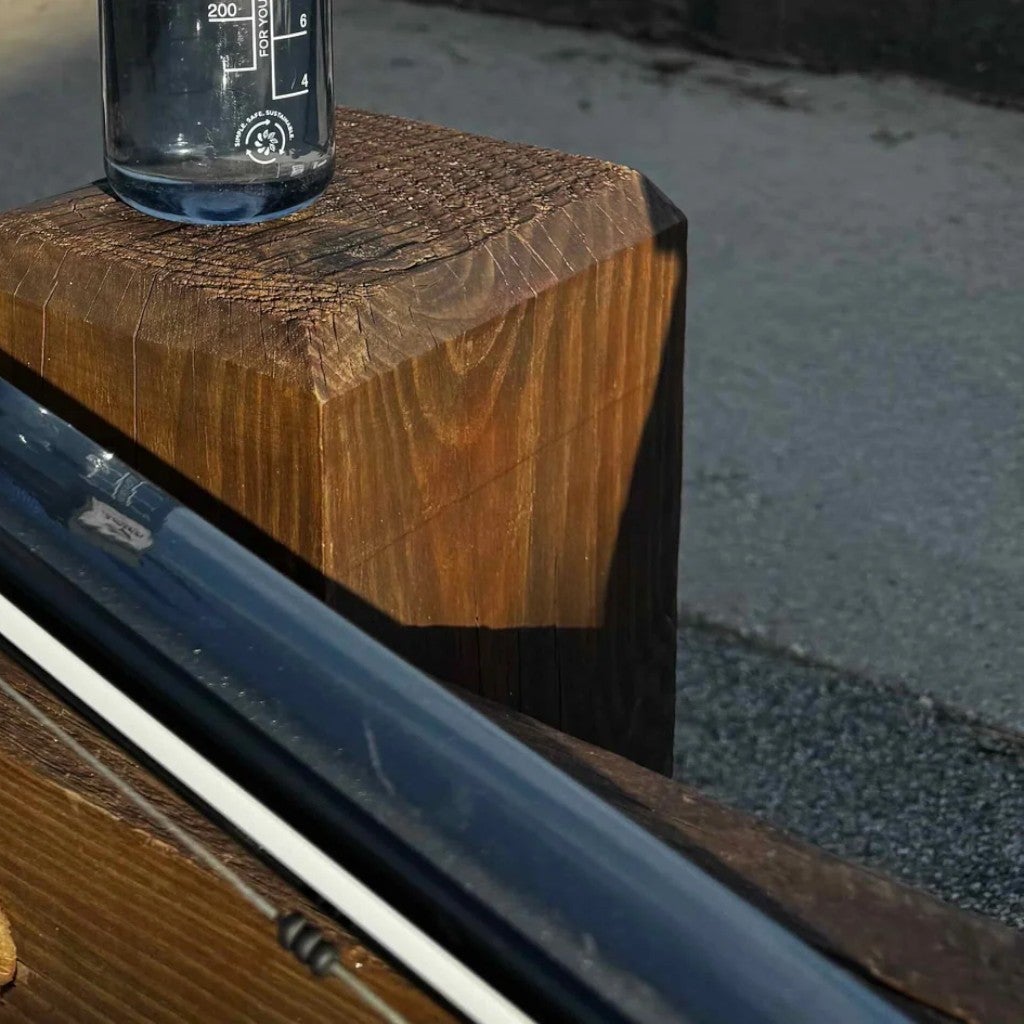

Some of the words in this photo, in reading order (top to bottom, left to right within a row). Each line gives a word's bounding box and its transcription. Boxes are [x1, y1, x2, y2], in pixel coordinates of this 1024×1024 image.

[207, 3, 237, 18] 200
[299, 13, 307, 28] 6
[258, 29, 270, 58] FOR
[301, 73, 309, 88] 4
